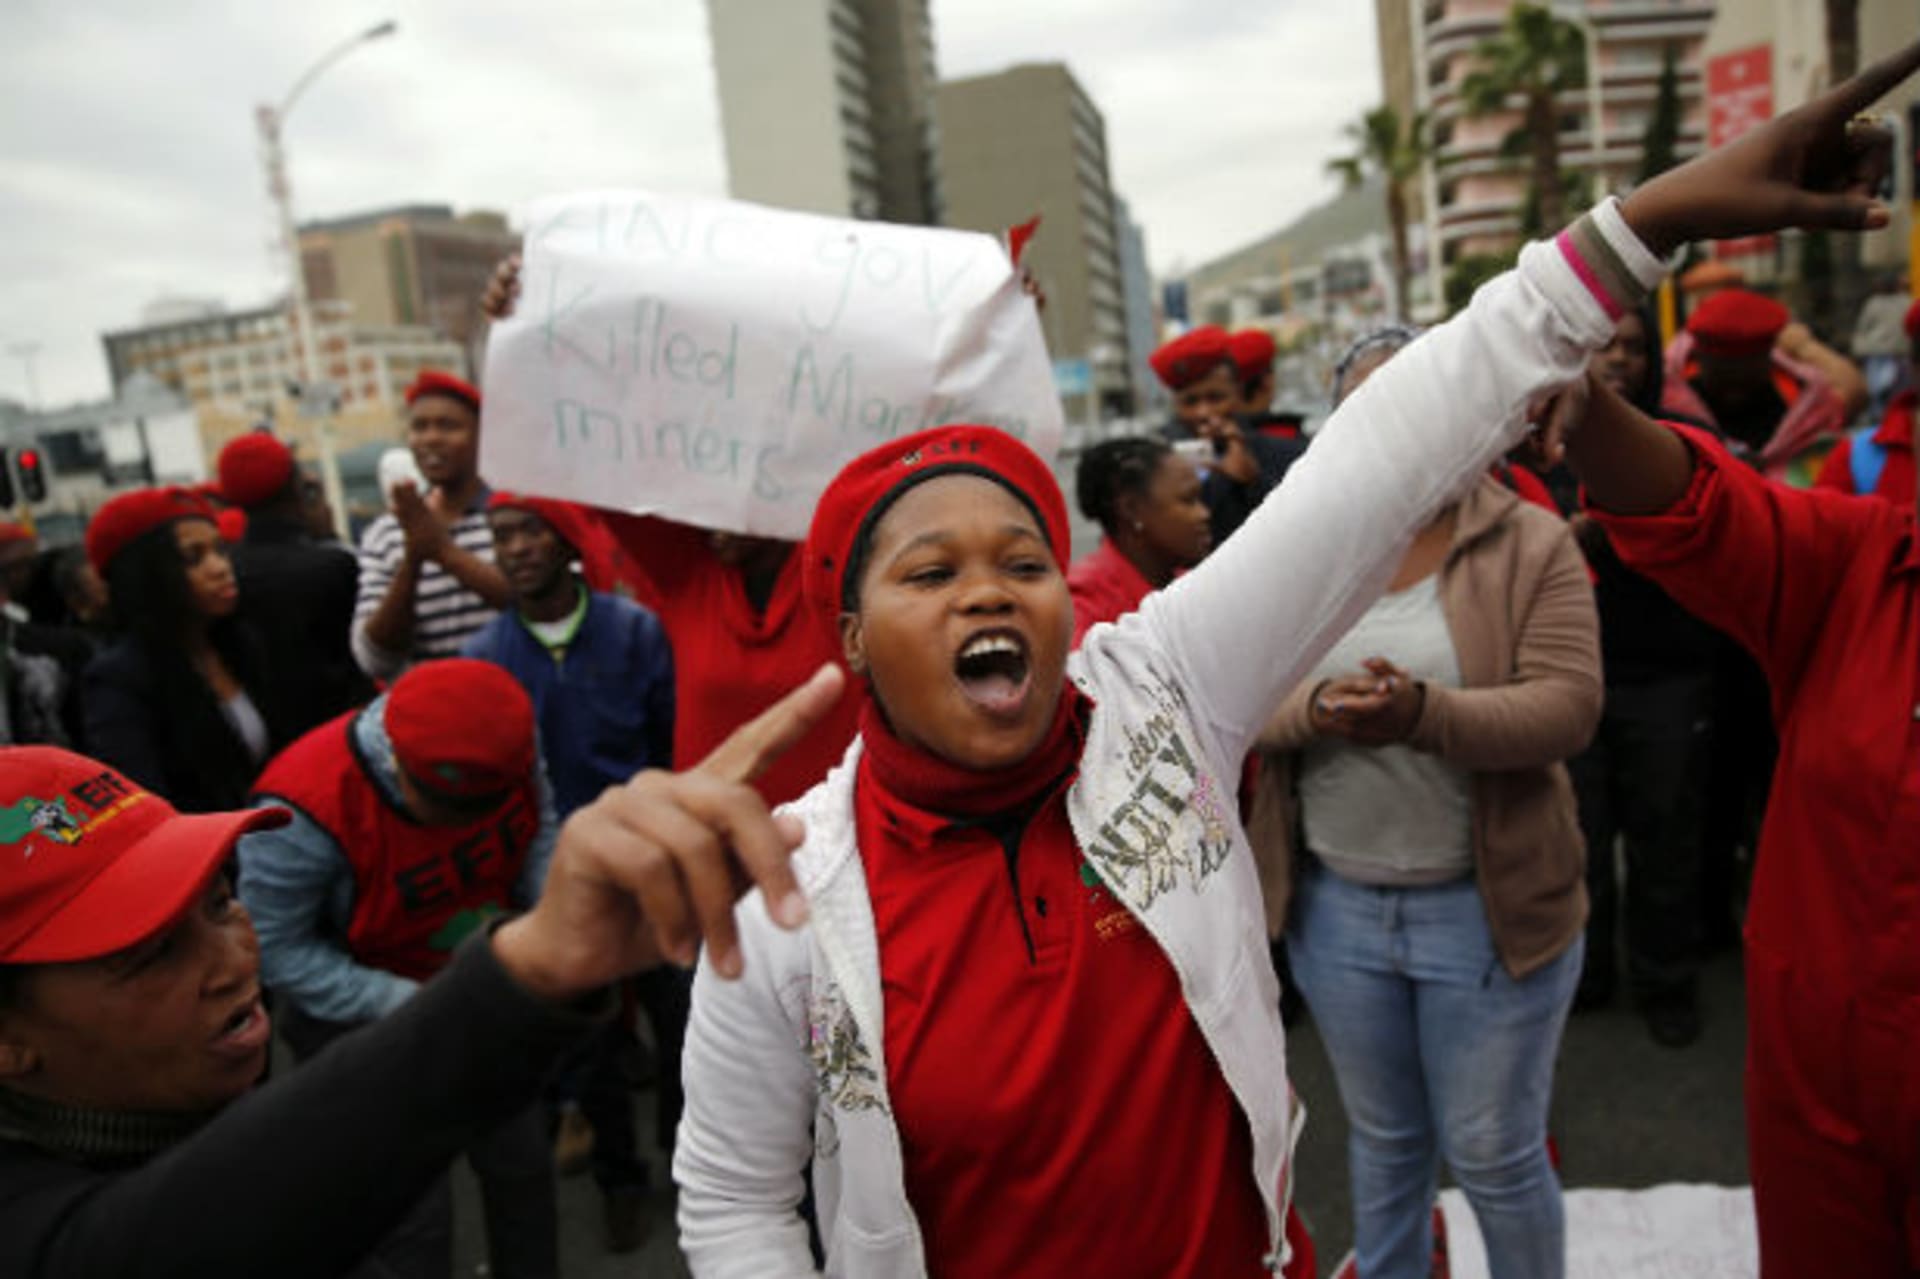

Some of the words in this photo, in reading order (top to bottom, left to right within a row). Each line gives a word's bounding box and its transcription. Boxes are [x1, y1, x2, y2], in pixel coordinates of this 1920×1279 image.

[543, 262, 738, 400] Killed
[553, 398, 782, 500] miners
[396, 803, 530, 912] EFF
